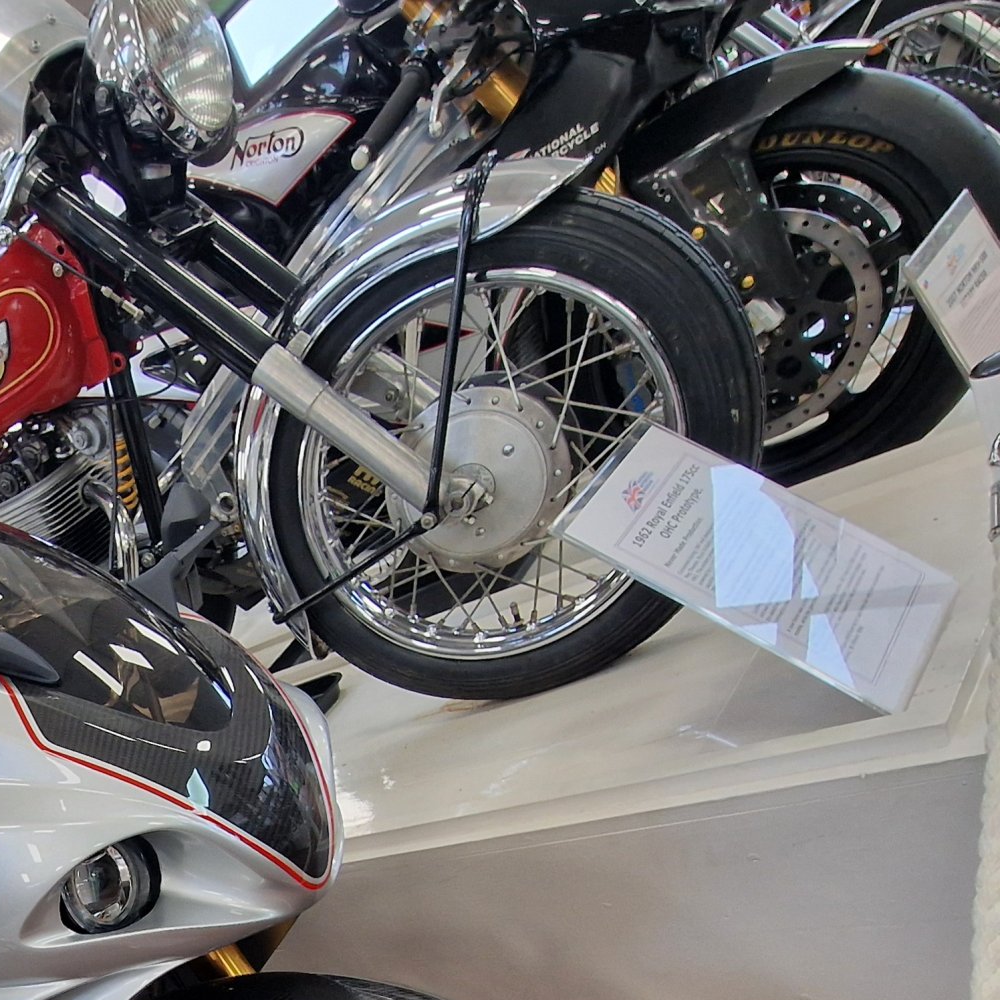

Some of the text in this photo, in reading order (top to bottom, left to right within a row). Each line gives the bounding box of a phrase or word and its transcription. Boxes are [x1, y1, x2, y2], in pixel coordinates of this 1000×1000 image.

[230, 126, 304, 171] Norton
[529, 122, 585, 158] ATIONAL
[757, 128, 896, 154] DUNLOP
[347, 475, 380, 495] RACIN
[632, 527, 653, 548] 1962
[646, 506, 668, 529] Royal
[661, 483, 685, 509] Enfield
[679, 463, 700, 485] 175cc
[660, 520, 678, 539] OHC
[671, 487, 704, 523] Prototype.
